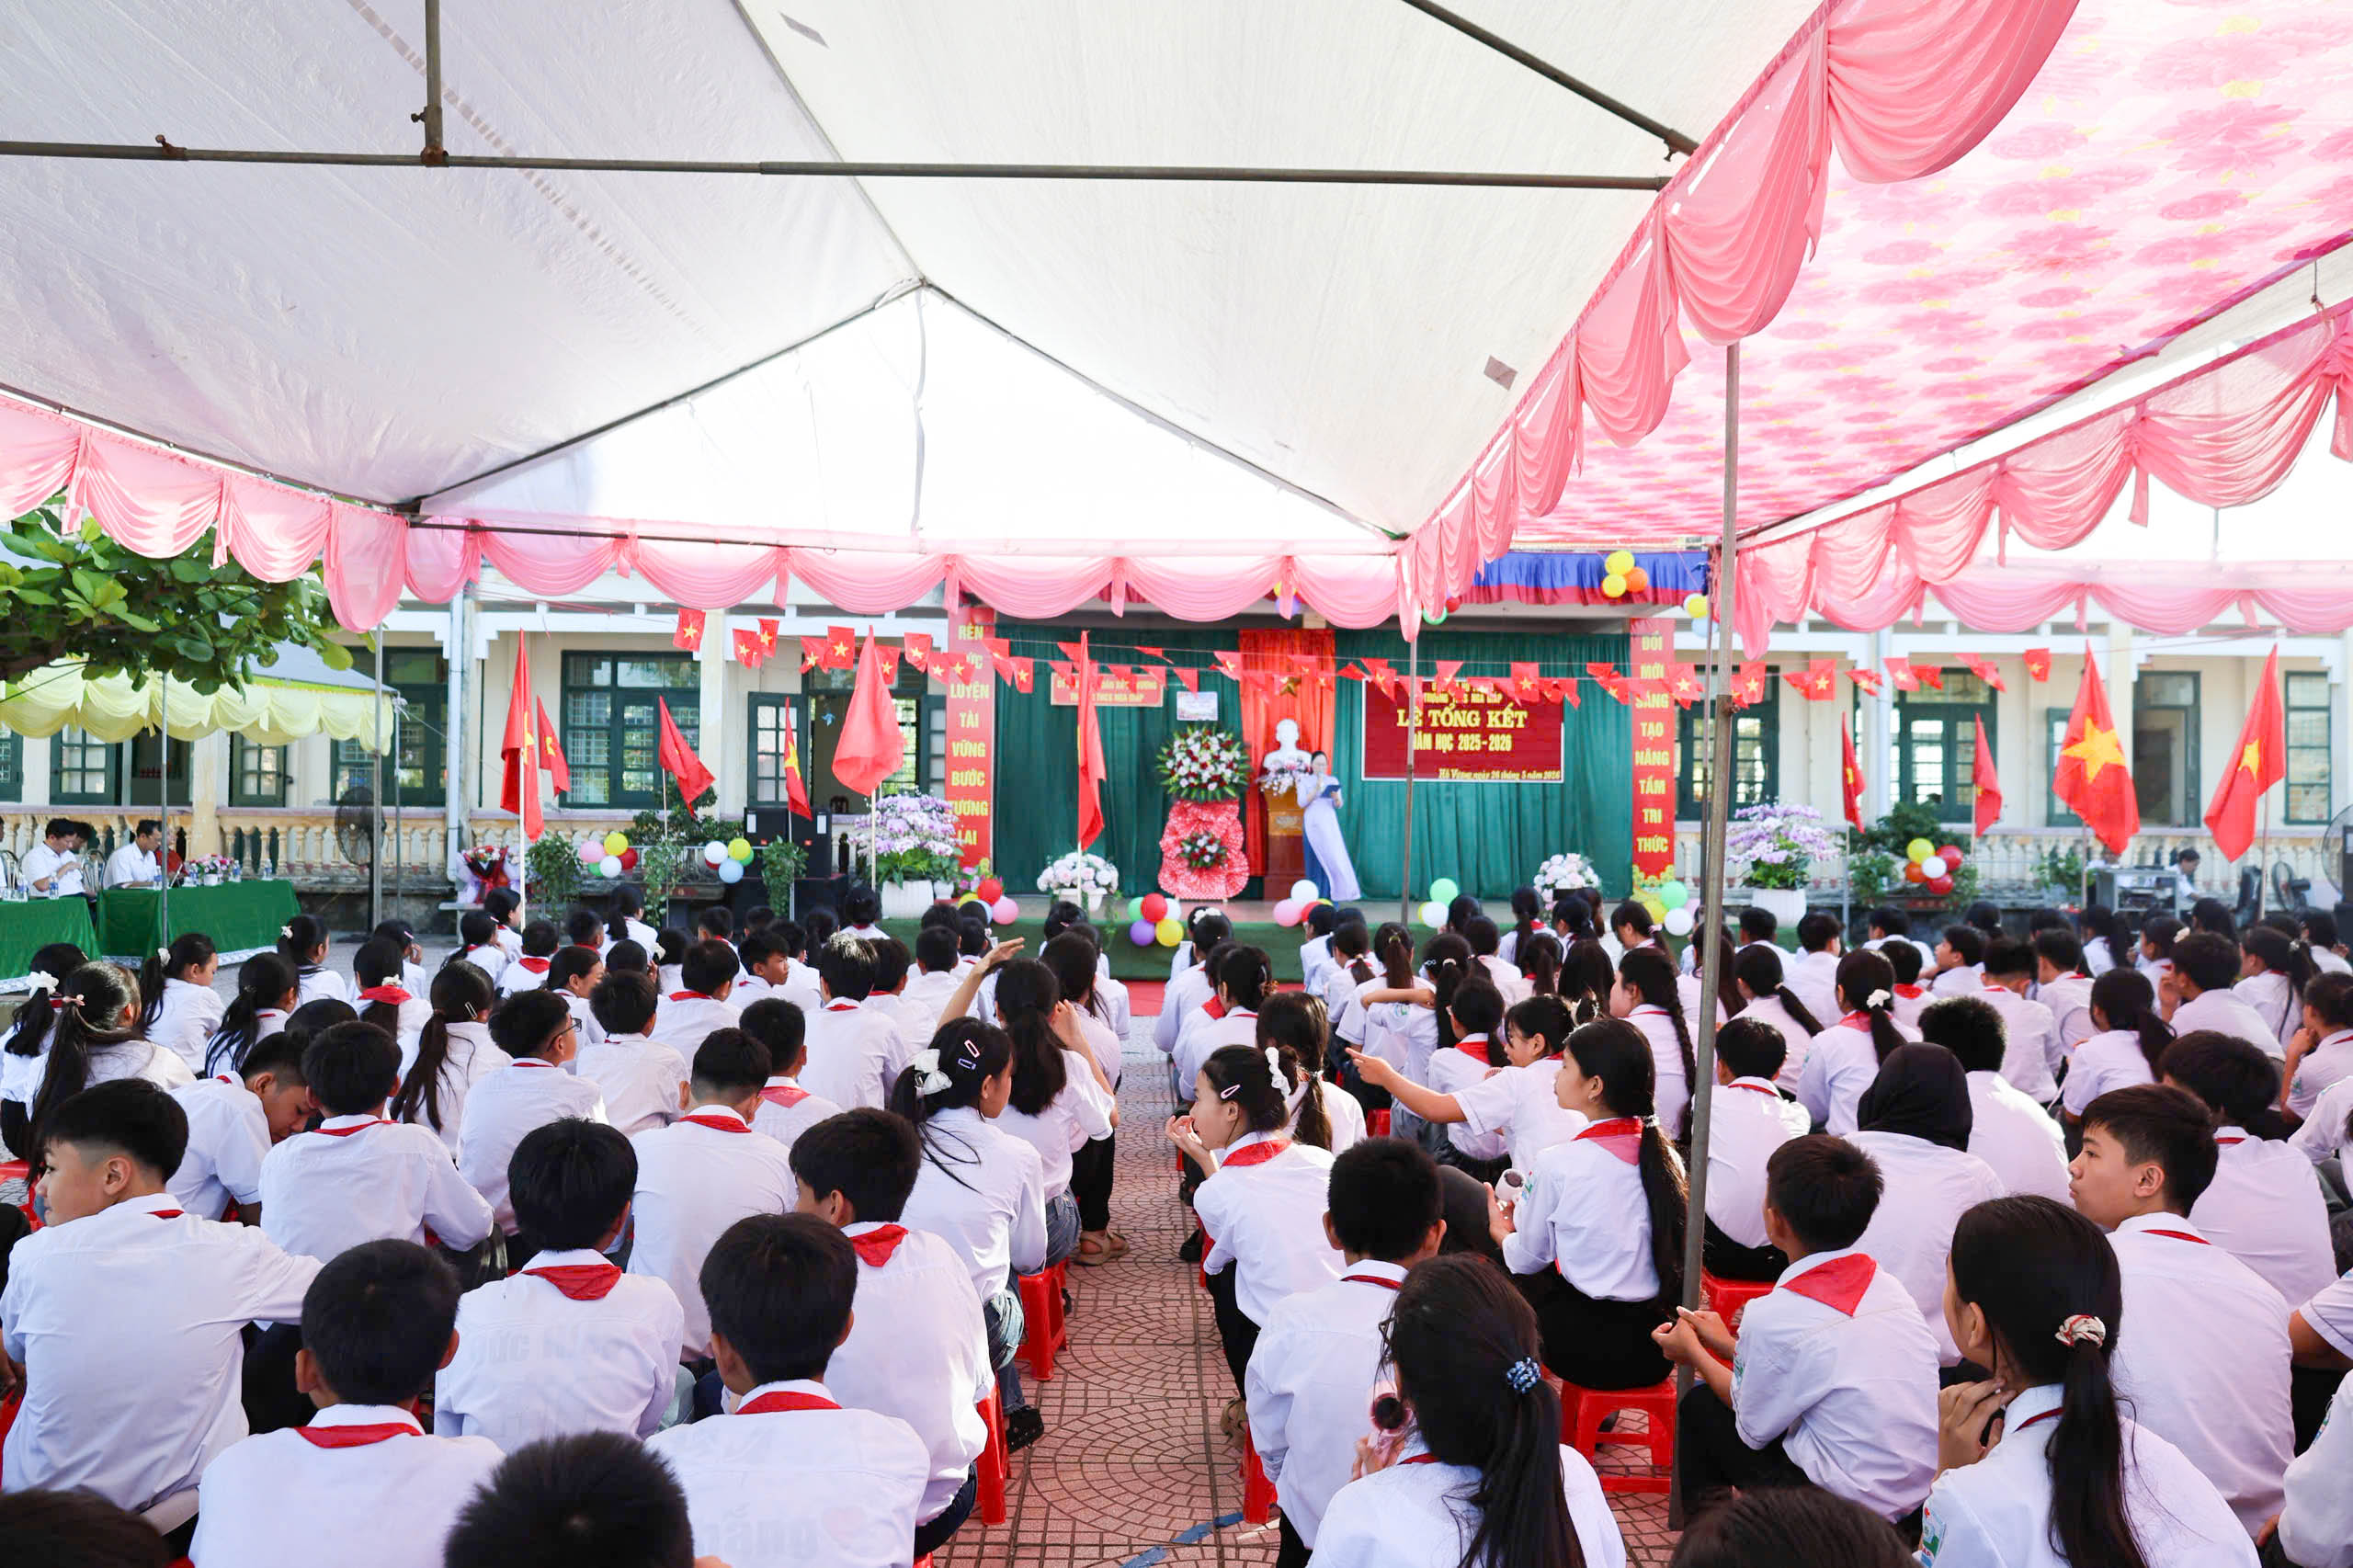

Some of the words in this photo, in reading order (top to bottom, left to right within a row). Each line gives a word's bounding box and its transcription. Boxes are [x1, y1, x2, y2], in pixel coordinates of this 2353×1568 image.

[950, 680, 989, 702] LUYỆN
[960, 710, 979, 728] TÀI
[1428, 702, 1481, 727] TỔNG
[1486, 701, 1529, 728] KẾT
[1640, 721, 1664, 741] TẠO
[951, 739, 986, 757] VỮNG
[1435, 733, 1454, 753] HỌC
[1635, 747, 1670, 766] NÂNG
[951, 767, 986, 787] BƯỚC
[1643, 809, 1663, 824] TRI
[1637, 834, 1668, 853] THỨC
